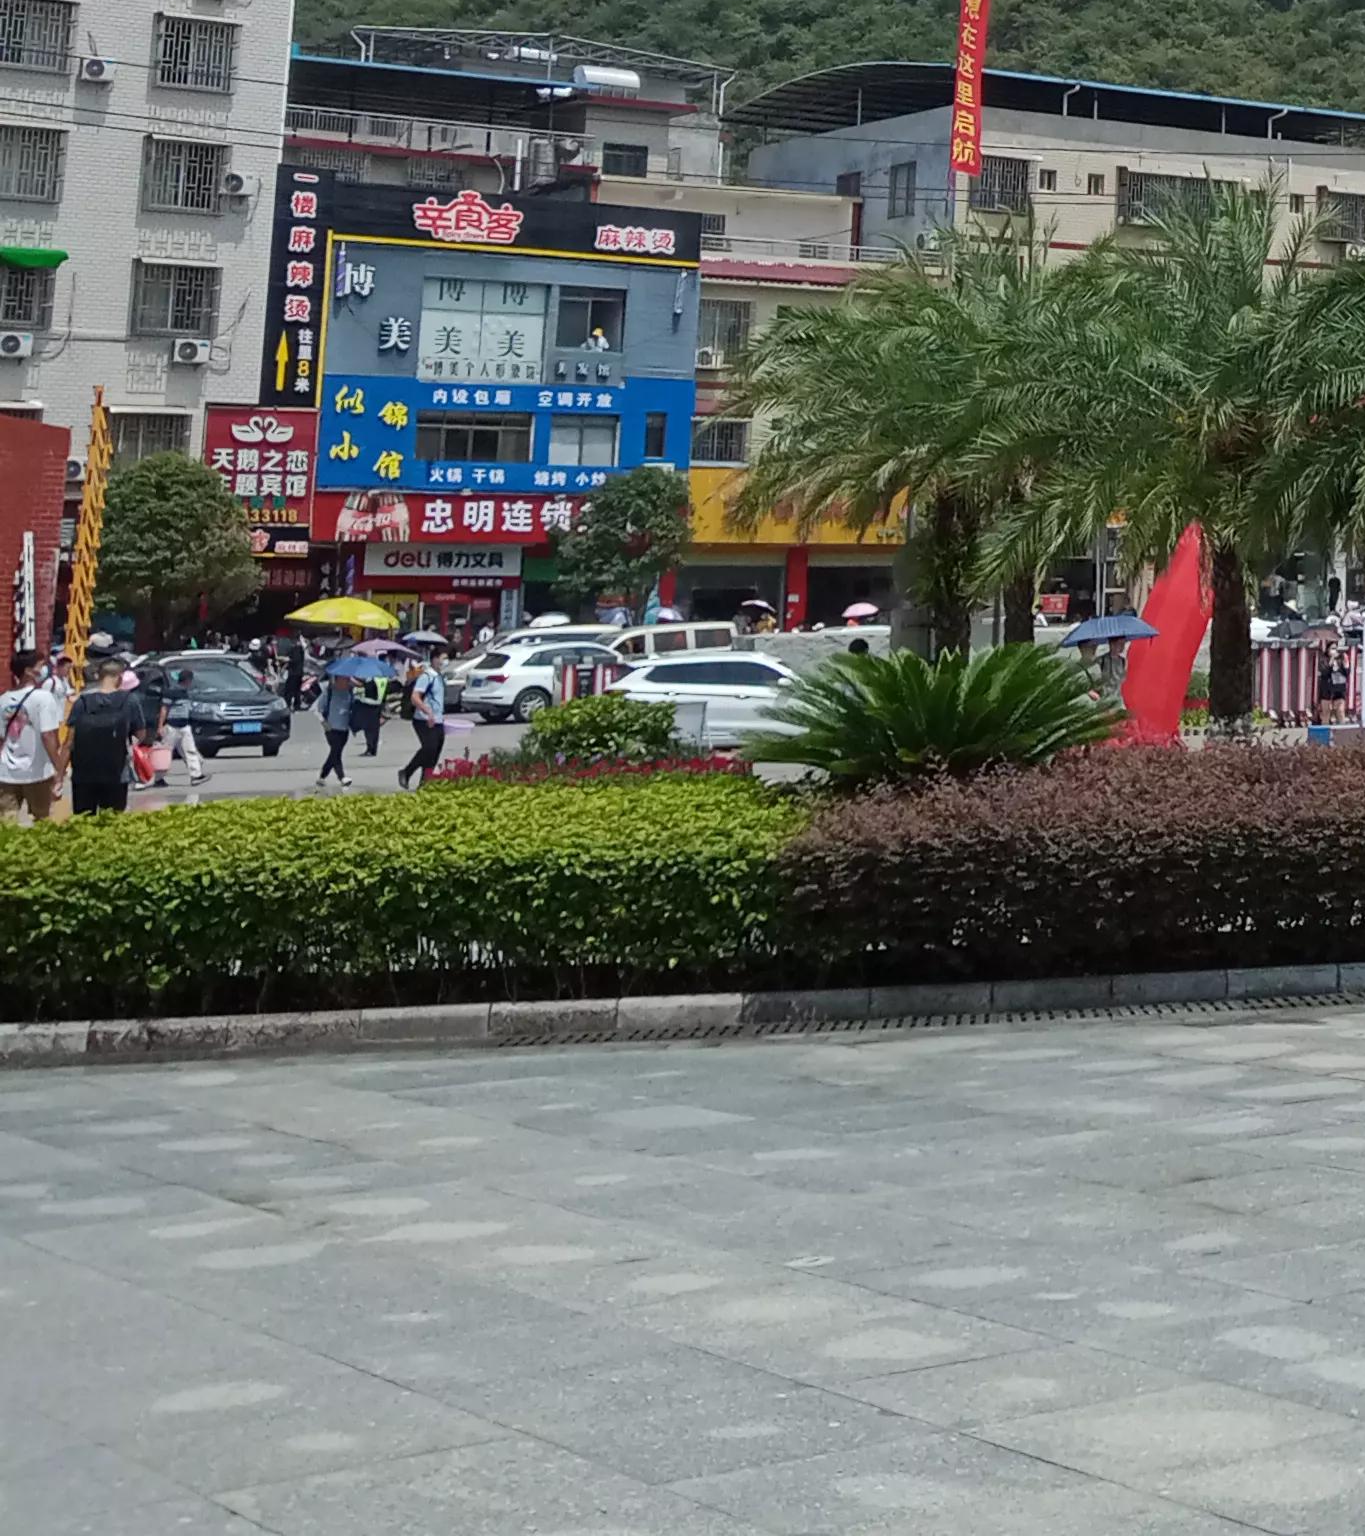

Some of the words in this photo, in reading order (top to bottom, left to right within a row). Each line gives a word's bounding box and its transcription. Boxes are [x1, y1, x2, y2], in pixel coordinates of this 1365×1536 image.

[284, 173, 320, 322] 一楼麻辣烫
[596, 225, 675, 254] 麻辣烫
[537, 390, 613, 409] 空调开放
[211, 448, 309, 472] 天鹅之恋
[429, 467, 463, 484] 火锅
[421, 497, 593, 534] 忠明连锁
[384, 549, 430, 568] deli
[437, 550, 504, 569] 得力文具
